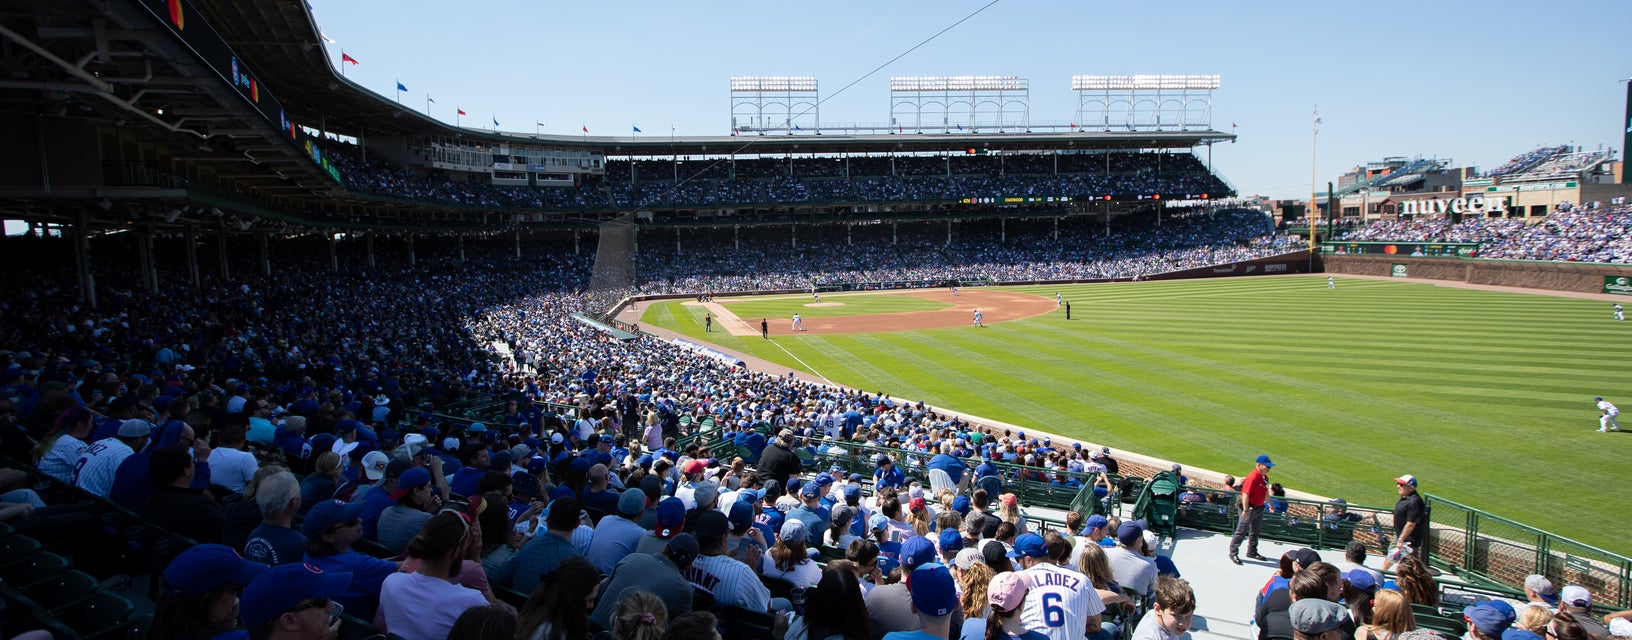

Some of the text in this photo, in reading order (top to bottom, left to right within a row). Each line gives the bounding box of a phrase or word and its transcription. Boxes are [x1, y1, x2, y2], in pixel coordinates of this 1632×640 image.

[1401, 196, 1504, 215] nuveen
[825, 420, 834, 428] 49
[1041, 592, 1065, 628] 6
